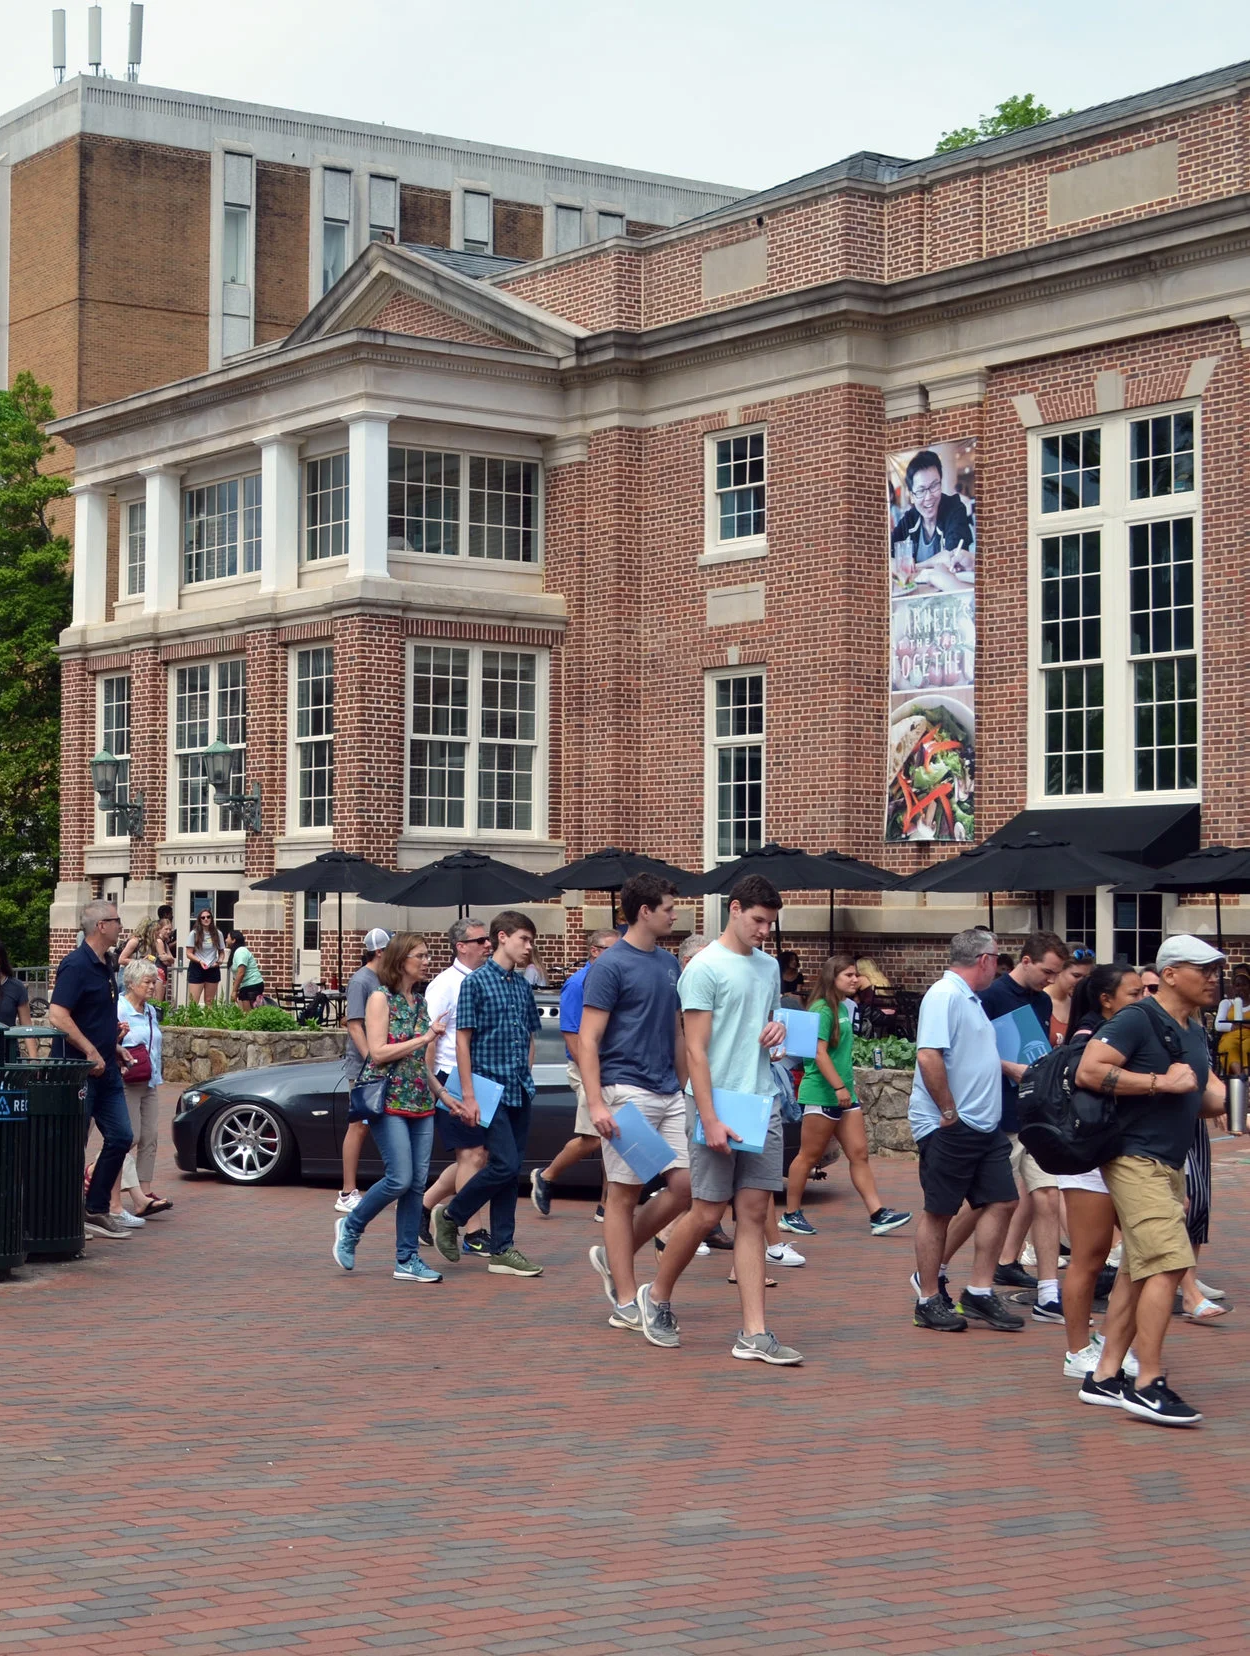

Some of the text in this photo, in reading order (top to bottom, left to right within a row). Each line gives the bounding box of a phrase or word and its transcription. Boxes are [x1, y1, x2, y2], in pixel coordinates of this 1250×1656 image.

[909, 636, 931, 648] THE
[165, 854, 245, 866] LENOIR HALL
